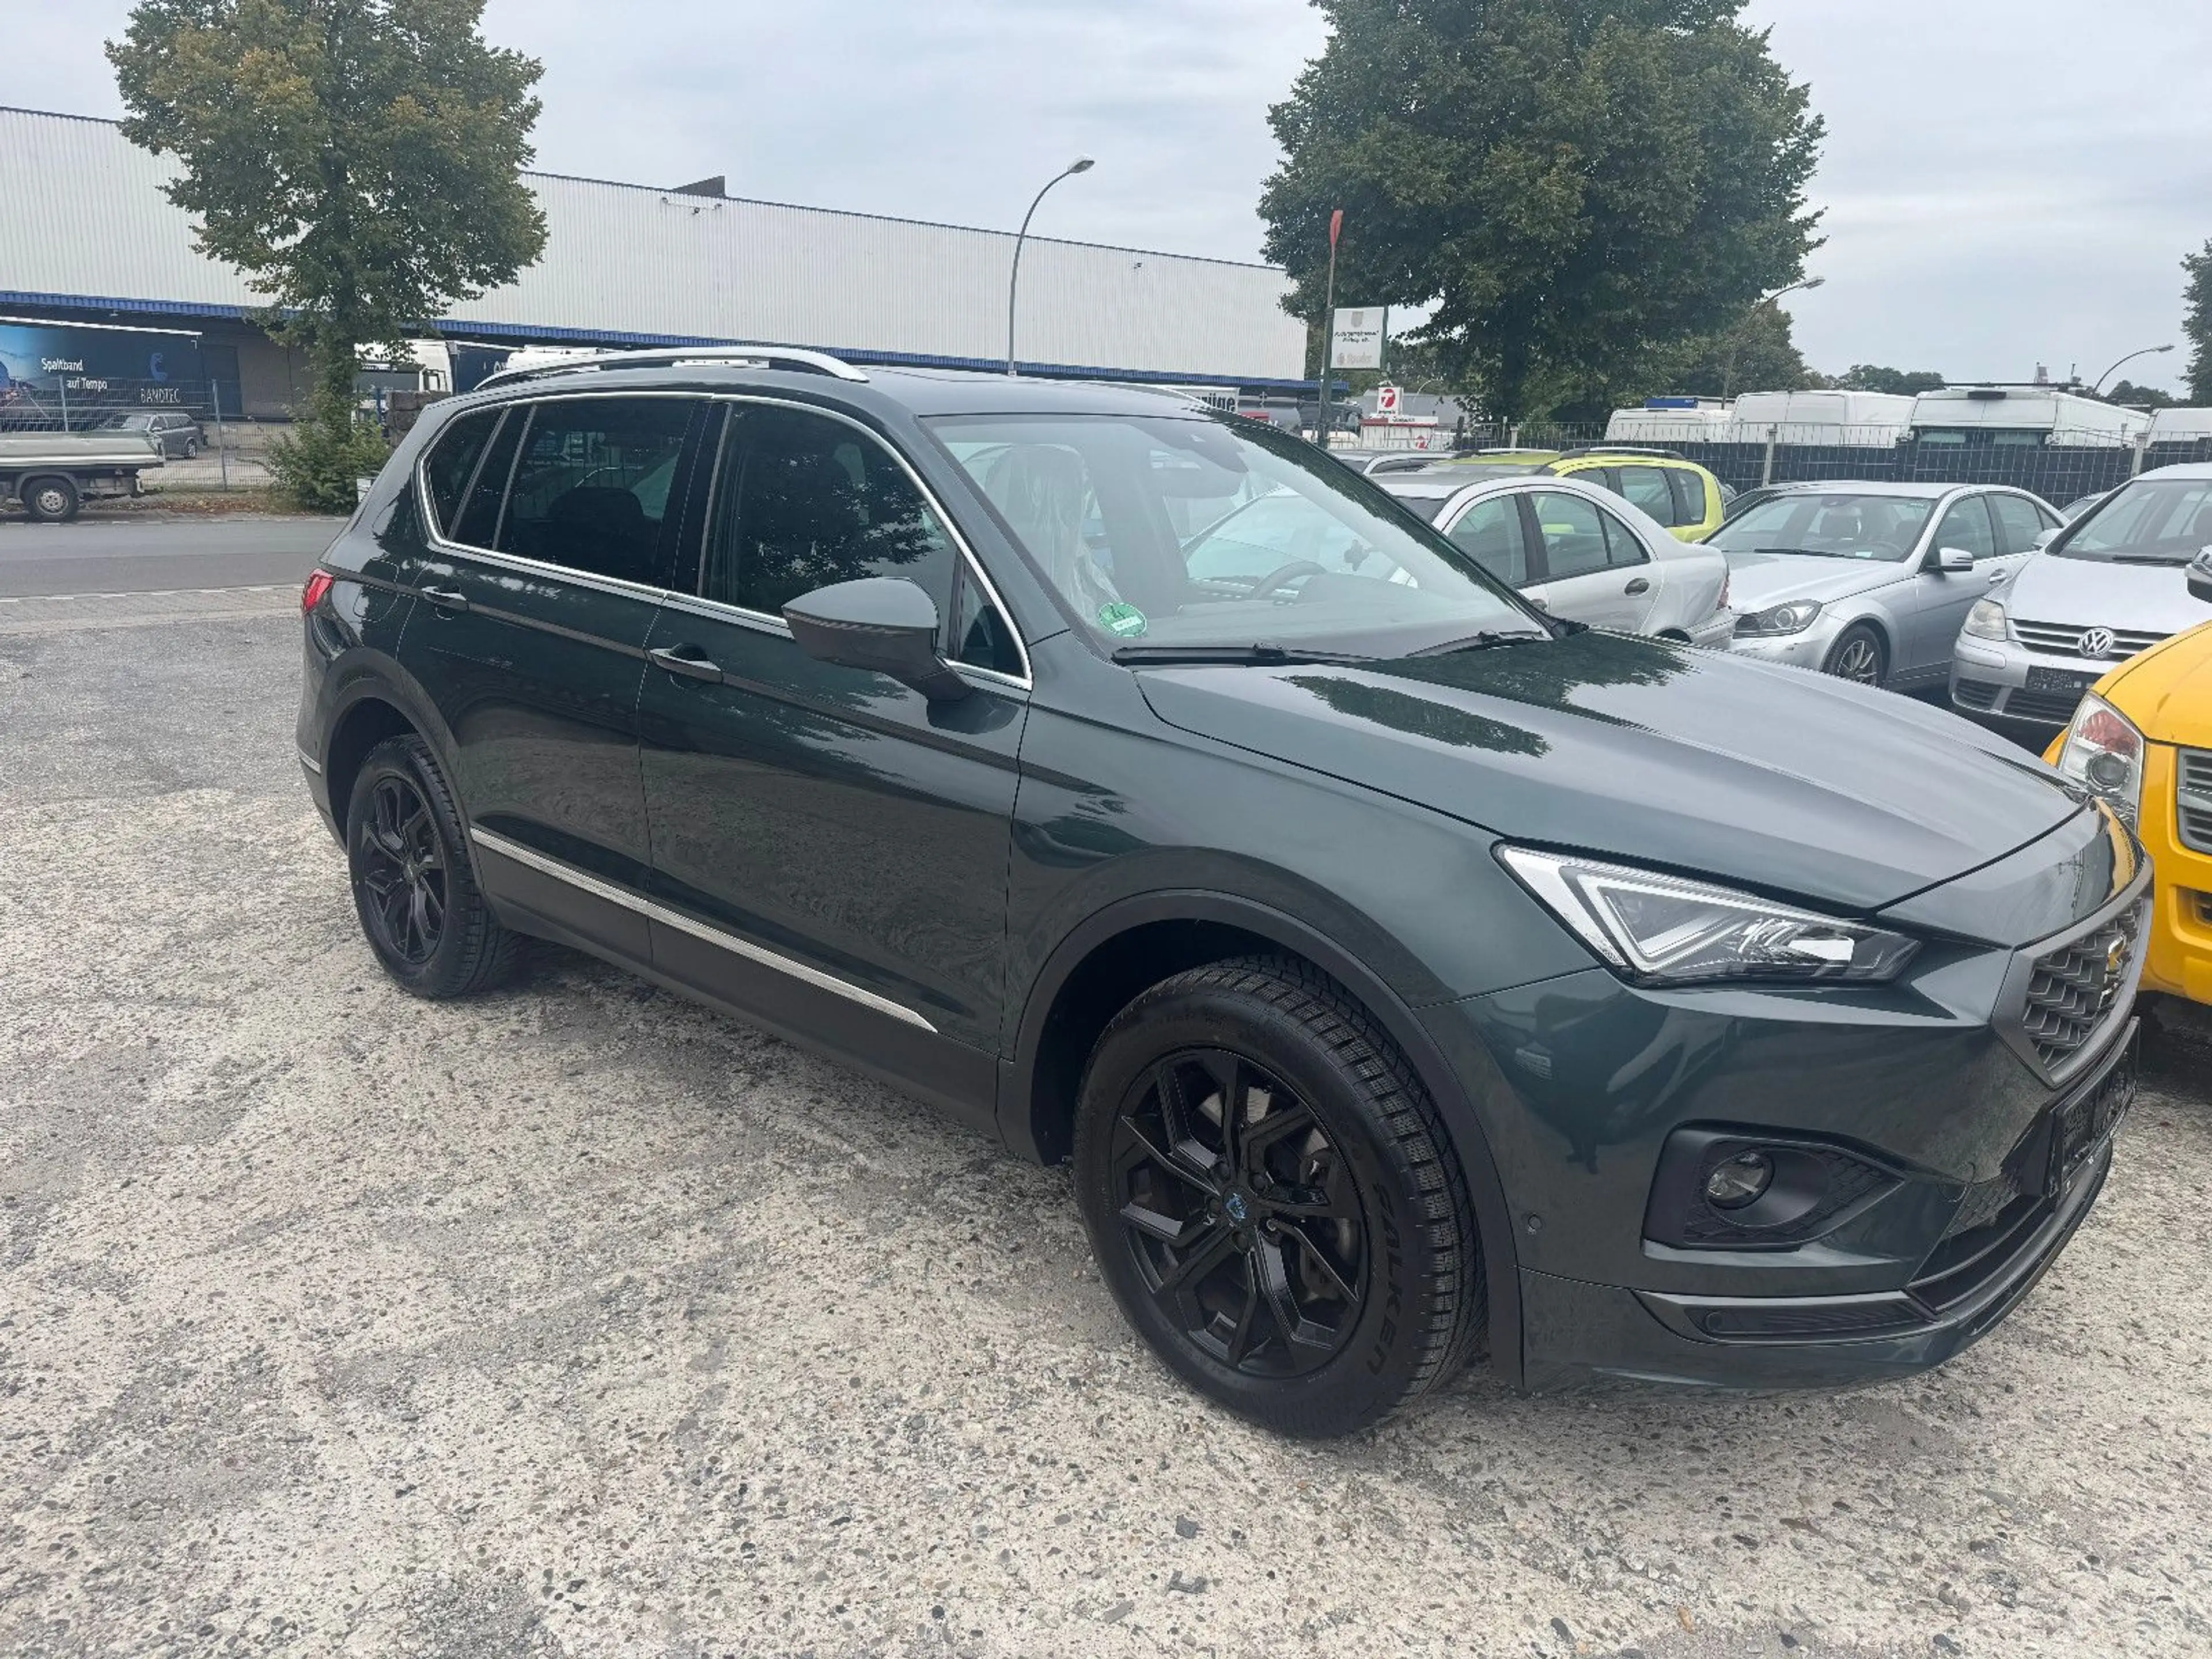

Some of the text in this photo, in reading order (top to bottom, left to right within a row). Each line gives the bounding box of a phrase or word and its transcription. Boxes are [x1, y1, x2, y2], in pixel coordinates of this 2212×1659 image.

[41, 357, 84, 373] Spaltband
[67, 377, 108, 392] auf Tempo
[141, 388, 180, 403] BANDTEC
